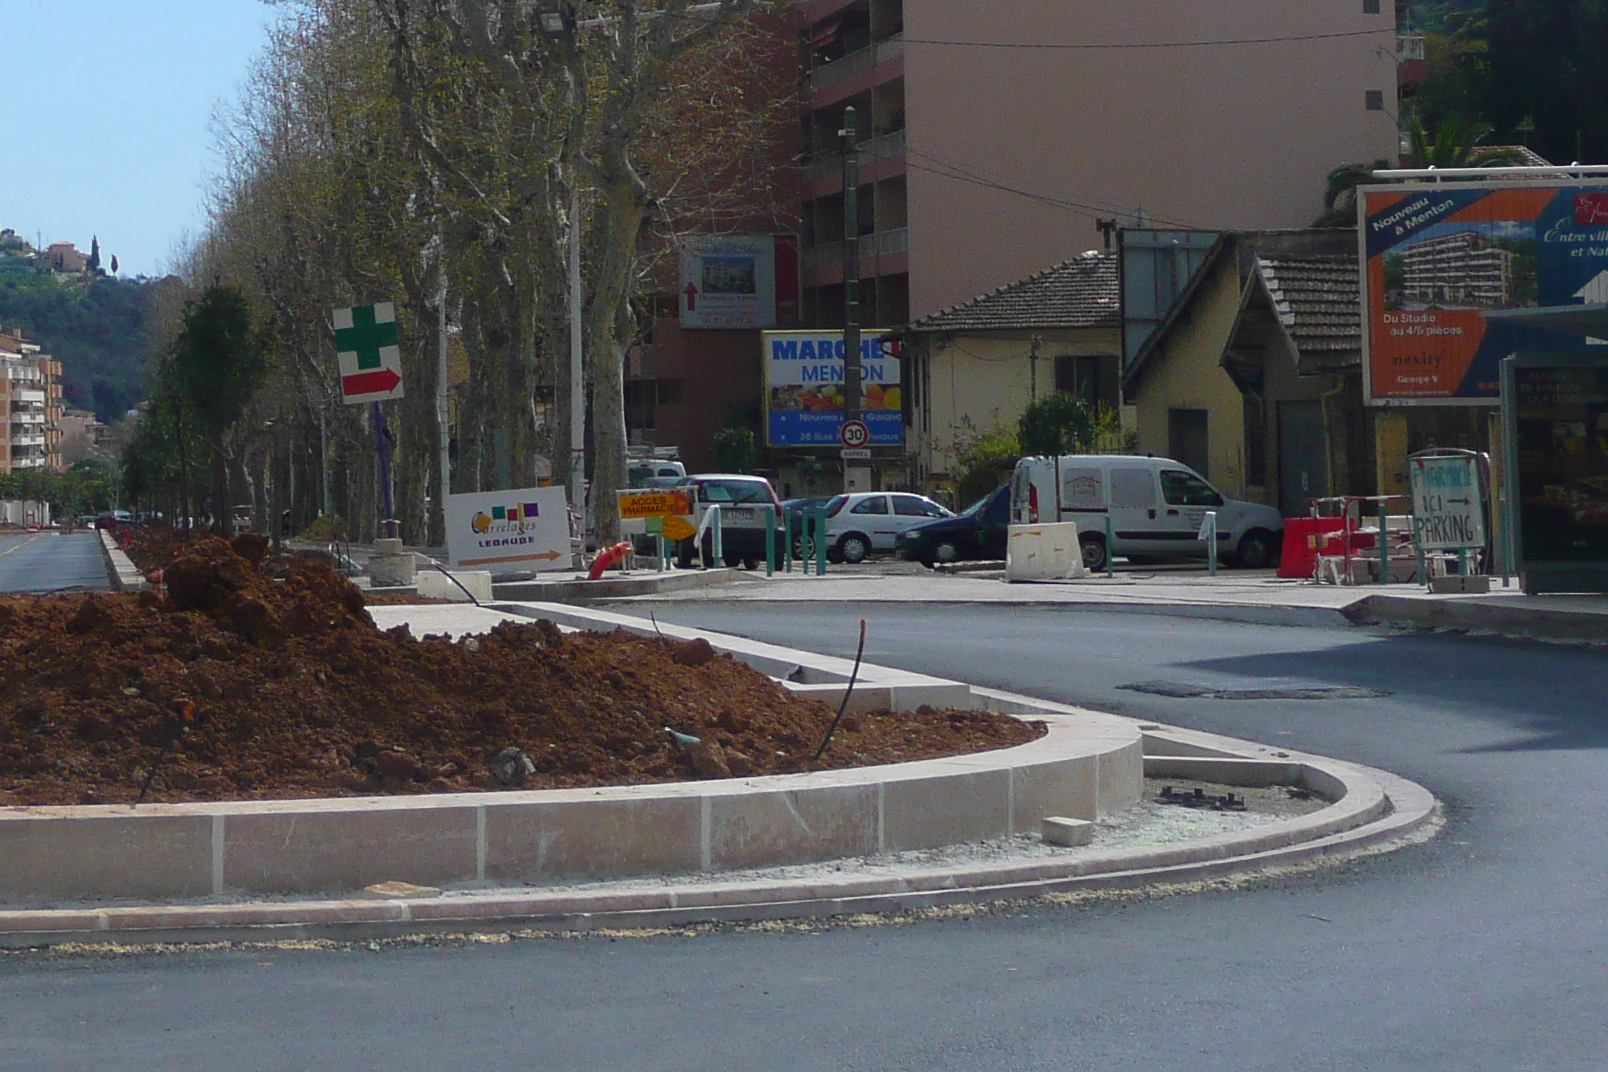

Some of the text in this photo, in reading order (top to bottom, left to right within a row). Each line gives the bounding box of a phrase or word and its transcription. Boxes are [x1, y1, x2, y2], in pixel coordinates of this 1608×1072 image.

[1373, 197, 1429, 232] Nouveau
[1394, 198, 1454, 235] à Menton
[1544, 217, 1586, 242] Entre
[1570, 247, 1583, 257] et
[1383, 313, 1436, 323] Du Studio
[1390, 325, 1462, 337] au 4/5 pièces
[1393, 351, 1441, 369] nexity
[802, 365, 883, 381] MENON
[1397, 375, 1429, 384] George
[847, 429, 862, 441] 30
[631, 496, 667, 505] ACCES
[1422, 494, 1442, 512] ICI
[623, 504, 675, 515] PHARMACIE
